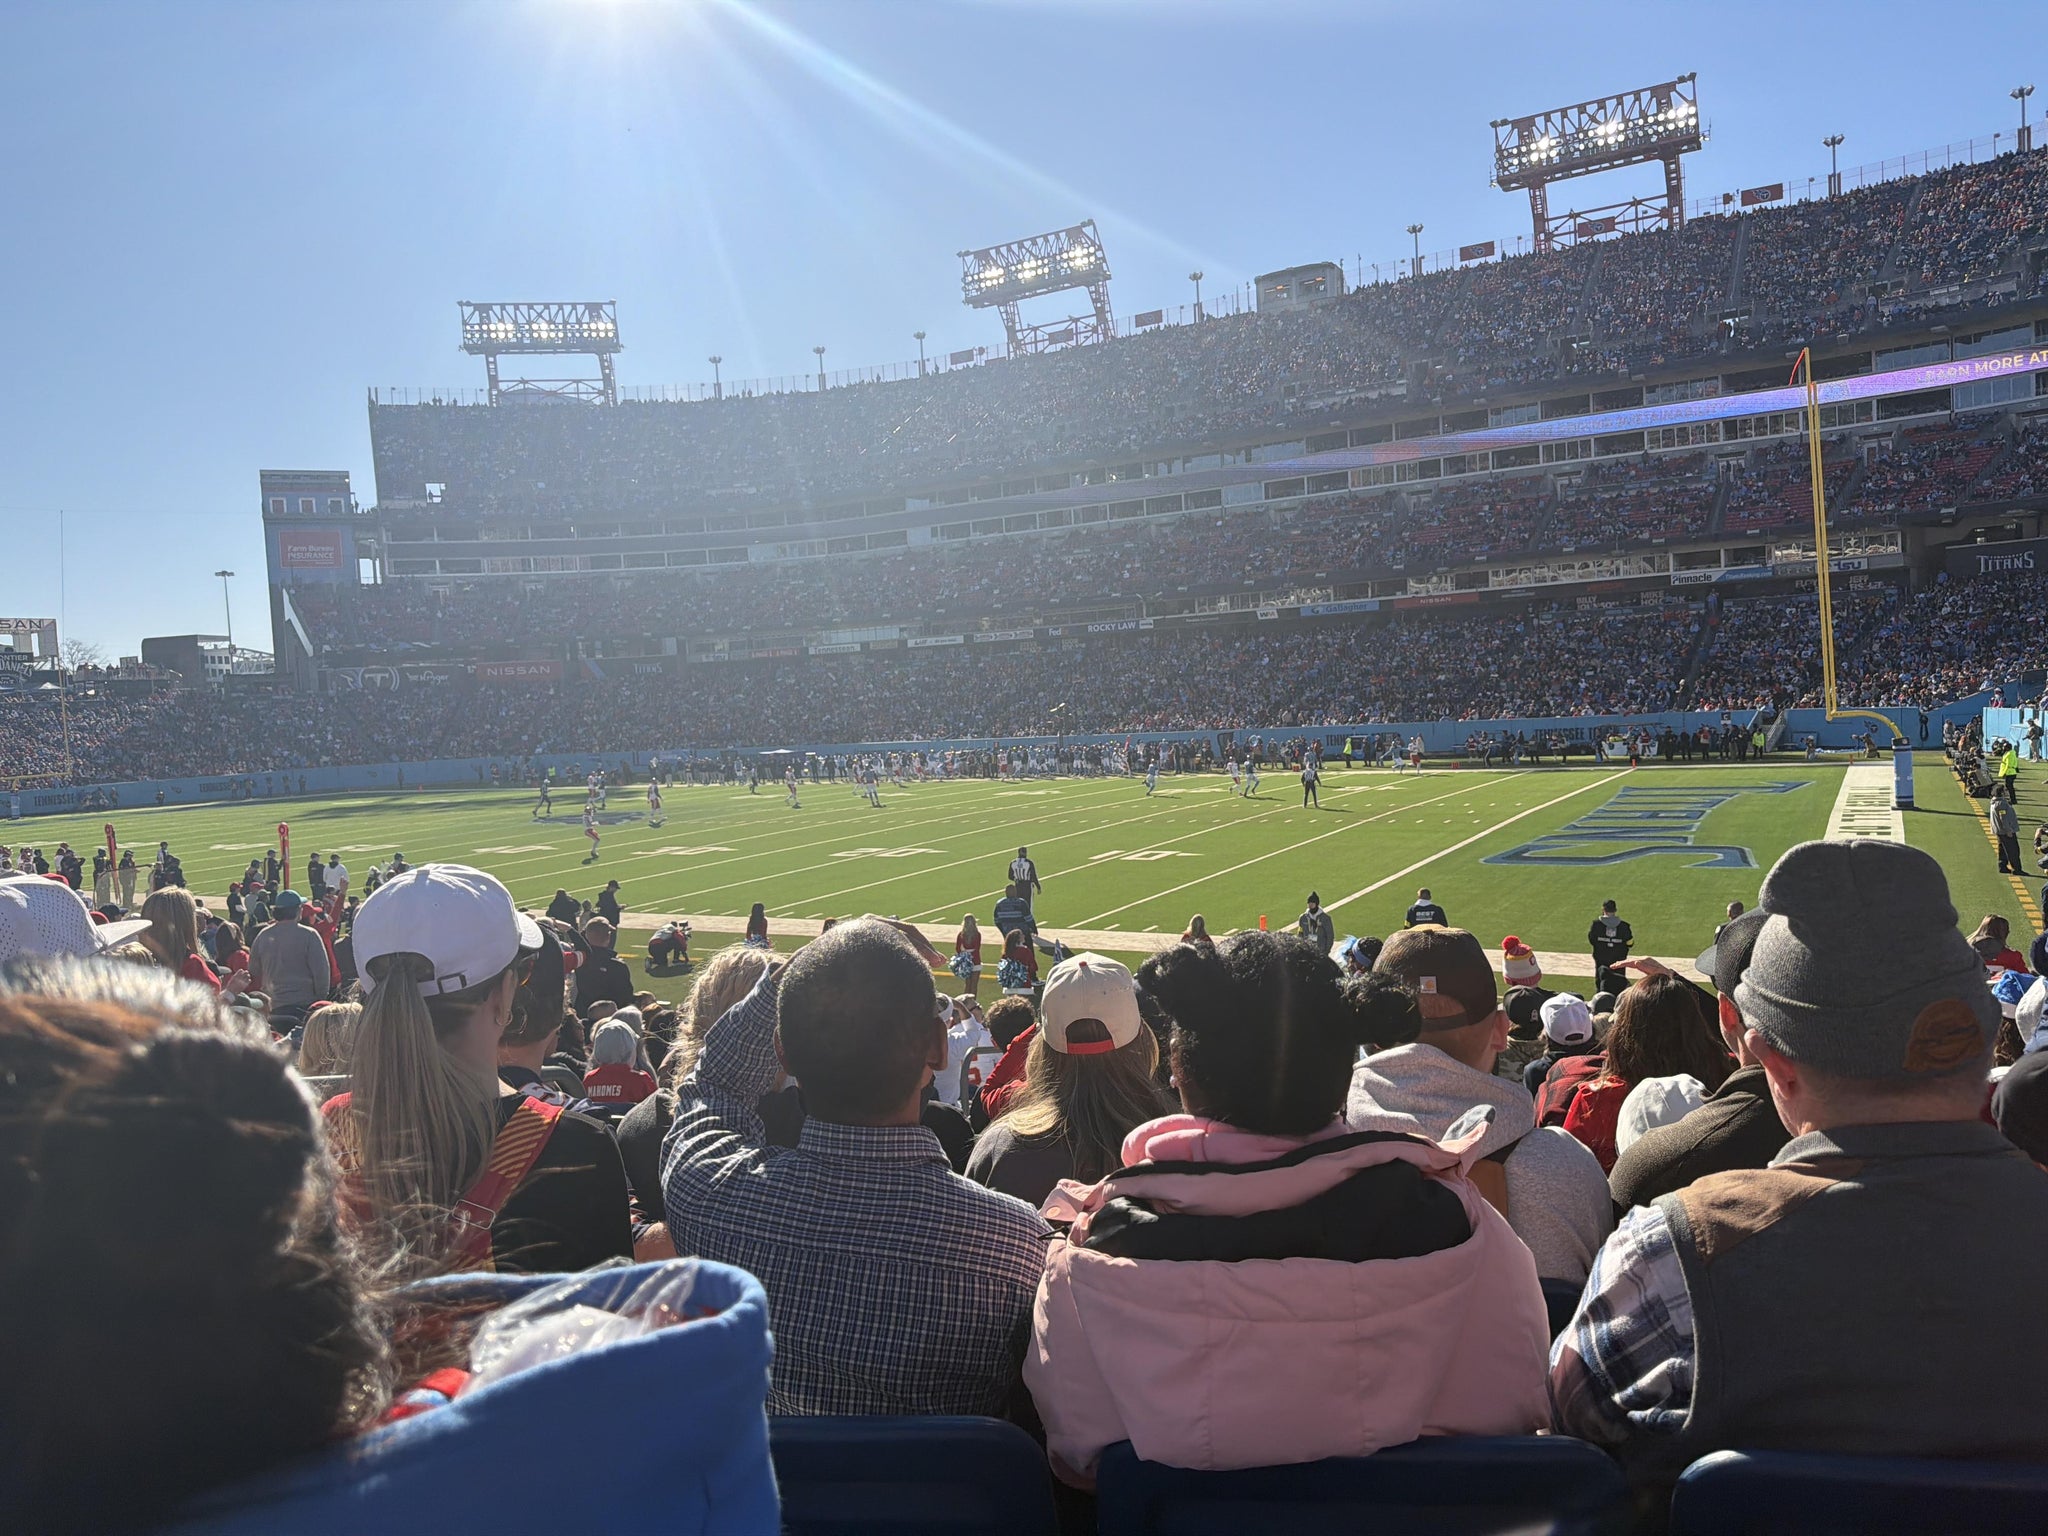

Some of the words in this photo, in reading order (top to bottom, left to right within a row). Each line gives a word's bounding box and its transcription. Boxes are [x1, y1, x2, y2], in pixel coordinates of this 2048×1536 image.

[1916, 365, 1970, 384] LEARN
[1974, 356, 2024, 374] MORE
[1976, 550, 2034, 575] TITANS
[1576, 595, 1597, 604] BILLY
[1087, 622, 1116, 633] ROCKY
[1117, 621, 1137, 631] LAW
[487, 665, 550, 677] NISSAN
[1479, 781, 1816, 869] TITANS
[829, 848, 932, 858] 20
[1089, 850, 1180, 861] 10
[587, 1085, 622, 1097] MAHOMES
